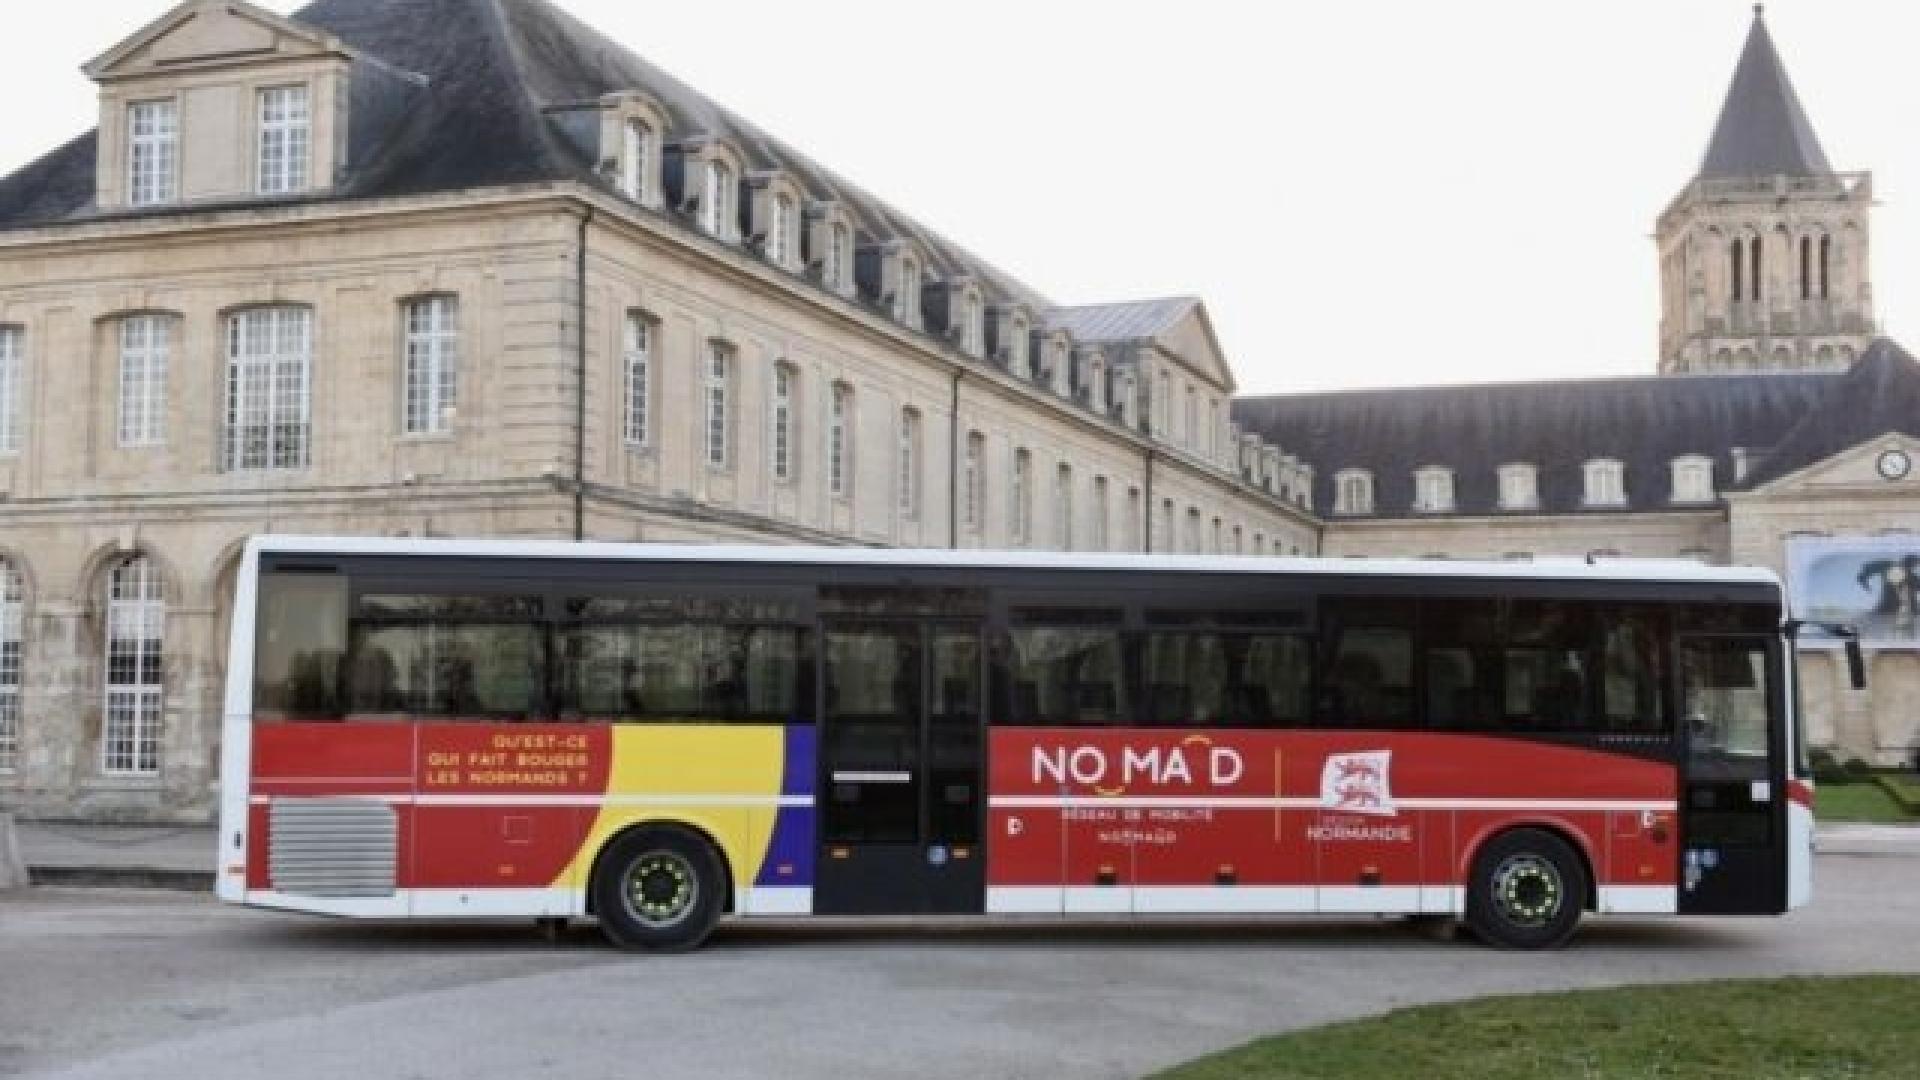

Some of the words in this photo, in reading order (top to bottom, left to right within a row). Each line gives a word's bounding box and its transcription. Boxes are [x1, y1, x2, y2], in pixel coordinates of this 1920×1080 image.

[468, 752, 507, 767] FAIT
[517, 752, 589, 767] BOUGER
[426, 770, 461, 785] LES
[468, 770, 569, 785] NORMANDS
